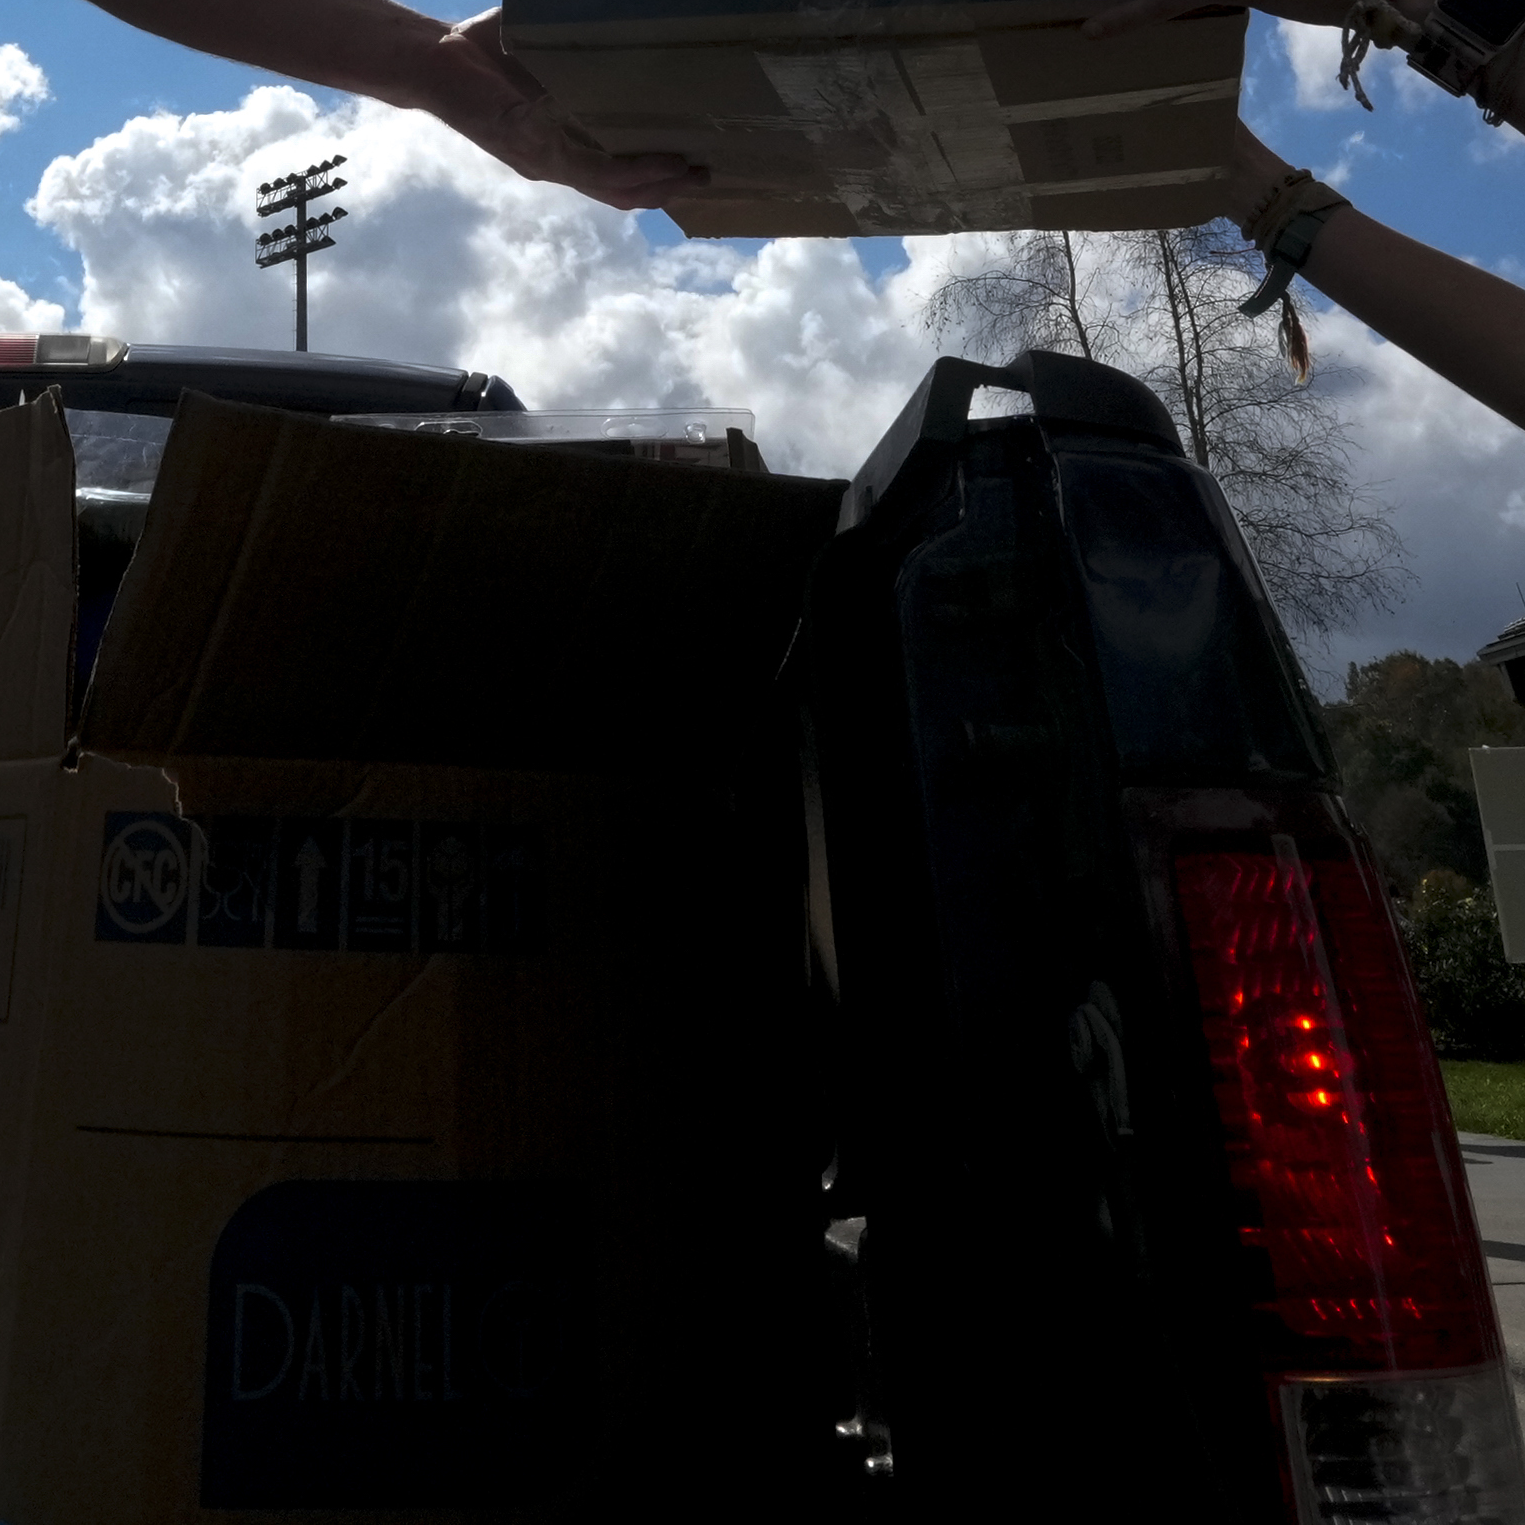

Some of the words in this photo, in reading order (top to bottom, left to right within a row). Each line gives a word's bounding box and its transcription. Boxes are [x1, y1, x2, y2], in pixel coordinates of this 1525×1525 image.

[108, 847, 179, 908] CFC
[353, 836, 411, 905] 15
[231, 1280, 464, 1403] DARNEL
